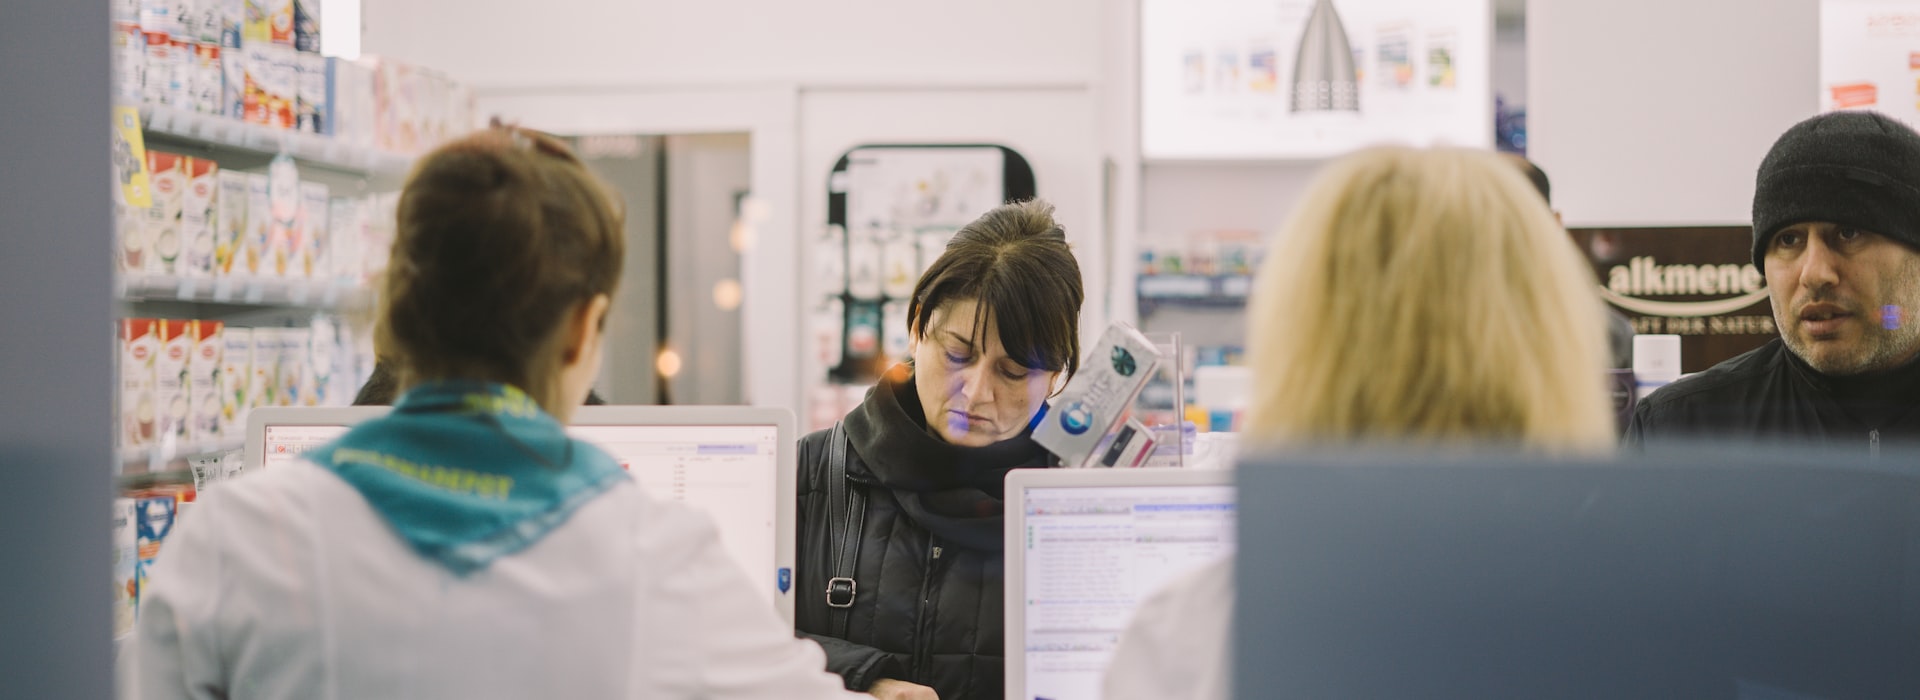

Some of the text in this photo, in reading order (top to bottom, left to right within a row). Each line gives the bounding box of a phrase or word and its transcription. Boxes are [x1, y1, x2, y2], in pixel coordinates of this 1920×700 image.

[1608, 256, 1762, 295] alkmene
[1631, 316, 1775, 334] AFT DER NATUR
